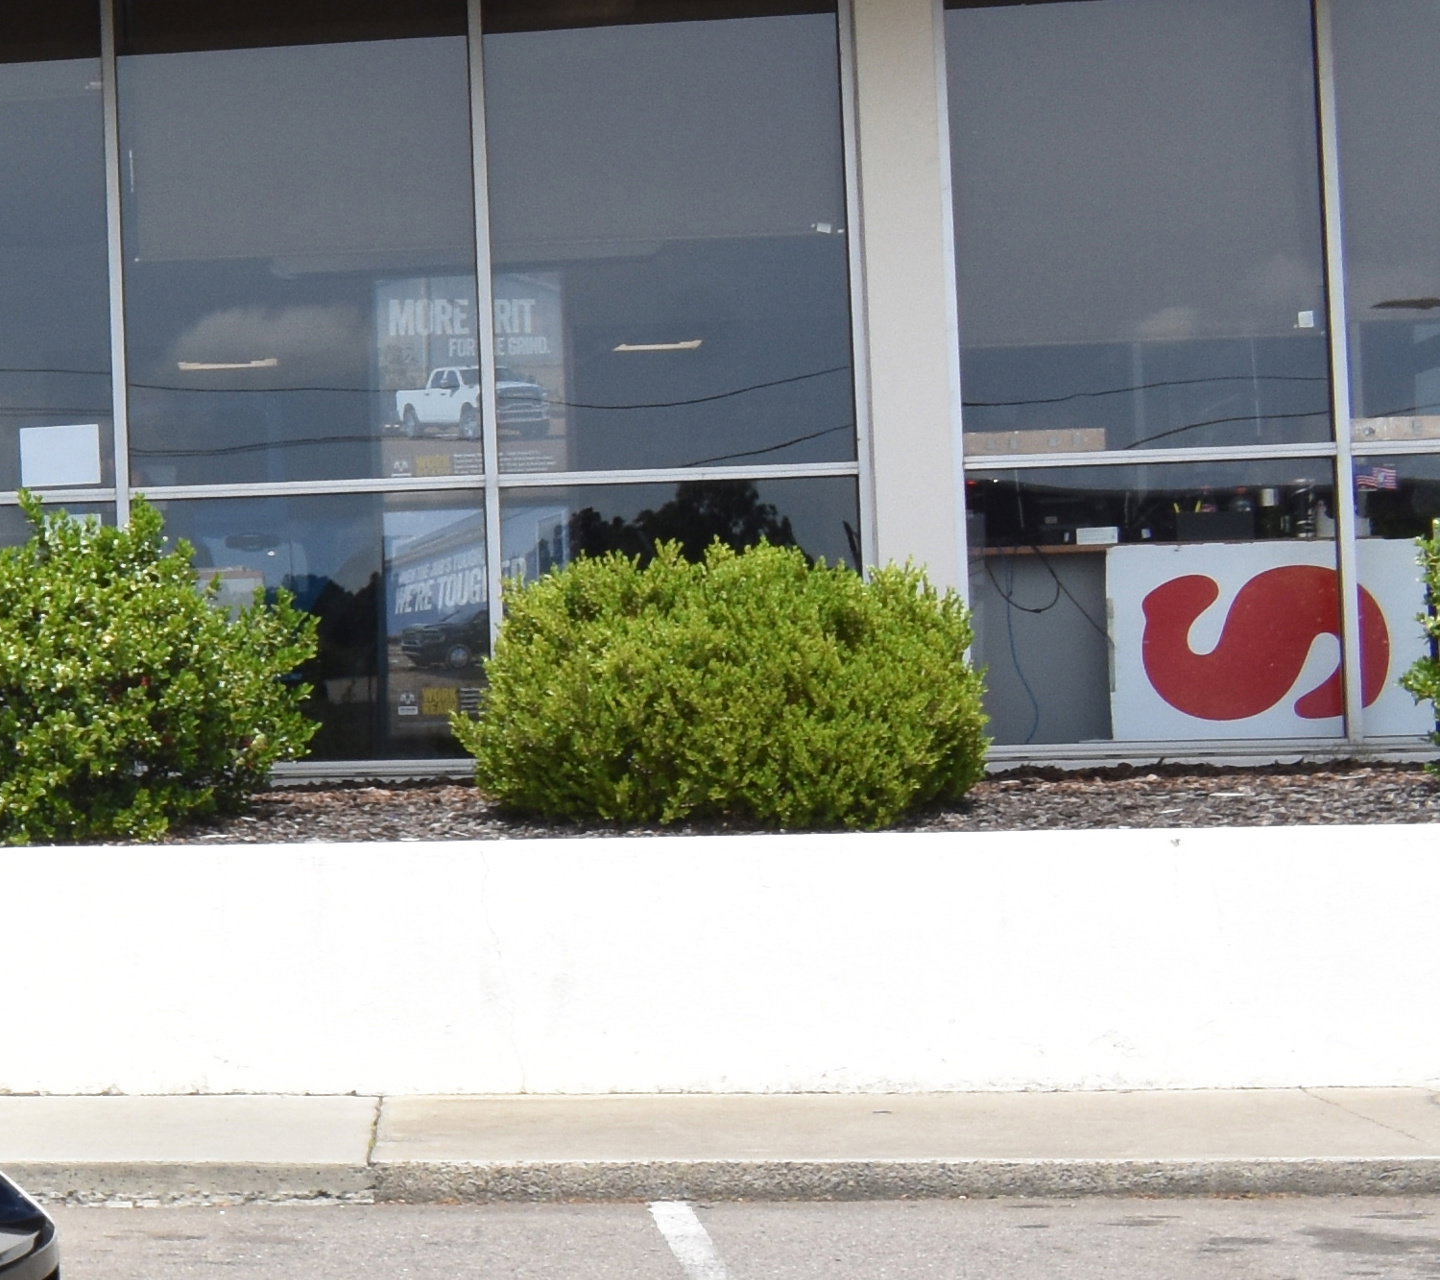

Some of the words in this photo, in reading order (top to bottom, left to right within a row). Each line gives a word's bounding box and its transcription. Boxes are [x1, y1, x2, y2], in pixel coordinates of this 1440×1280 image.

[388, 299, 470, 336] MORE
[492, 298, 536, 334] RIT
[448, 337, 475, 357] FOR
[395, 579, 432, 615] WE'RE
